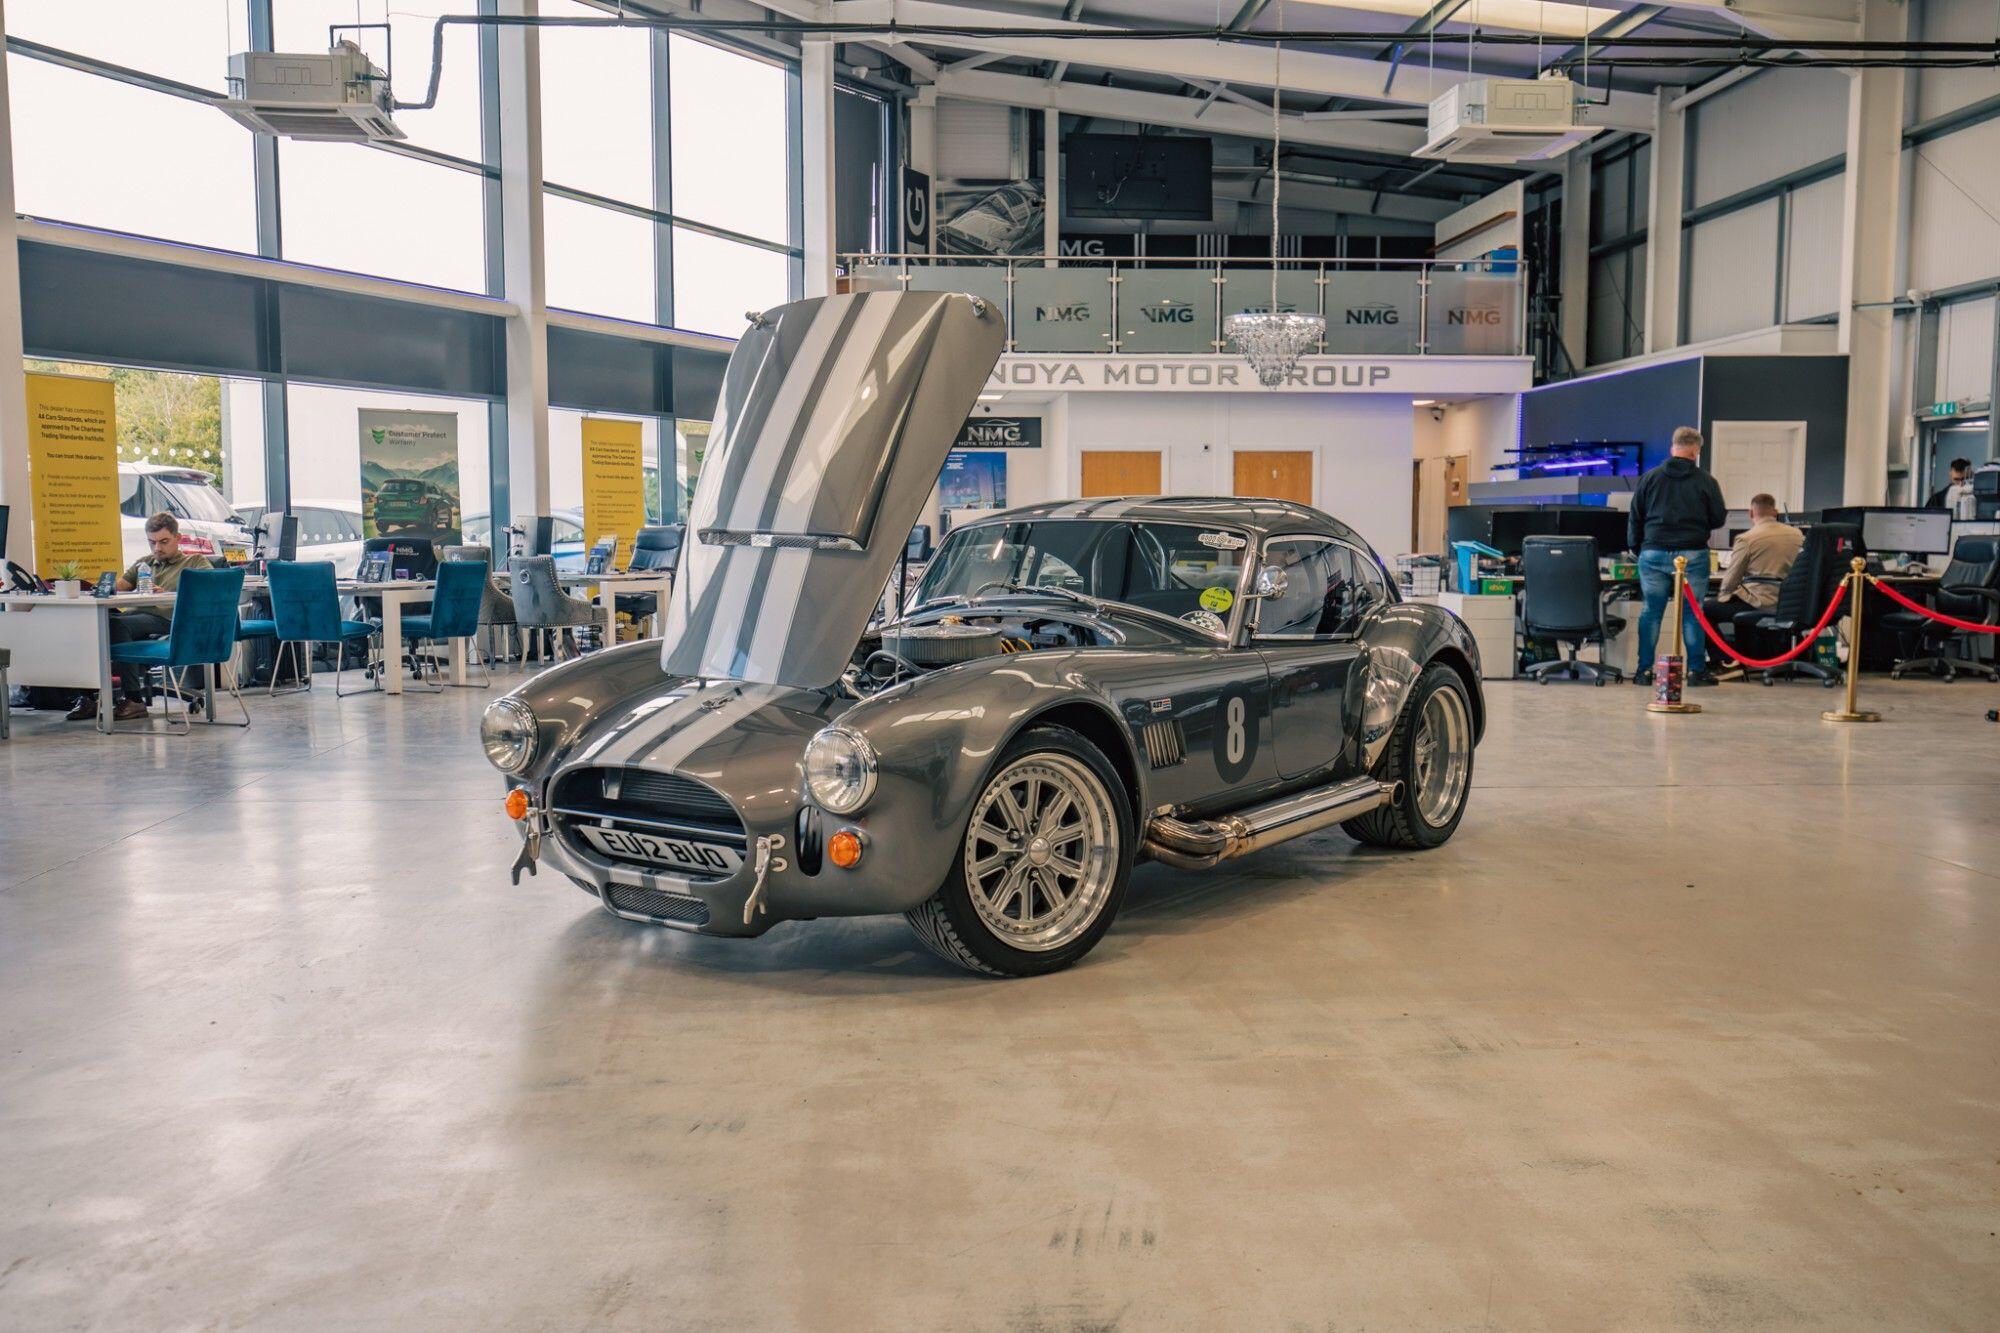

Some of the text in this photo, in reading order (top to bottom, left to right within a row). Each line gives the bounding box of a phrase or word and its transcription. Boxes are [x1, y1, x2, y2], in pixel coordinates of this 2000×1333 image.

[1346, 309, 1399, 325] NMG
[1448, 309, 1501, 325] NMG
[1104, 364, 1239, 385] MOTOR
[1260, 365, 1391, 386] ROUP
[388, 430, 448, 439] Customer Protect
[967, 426, 1021, 441] NMG
[1227, 696, 1245, 764] 8
